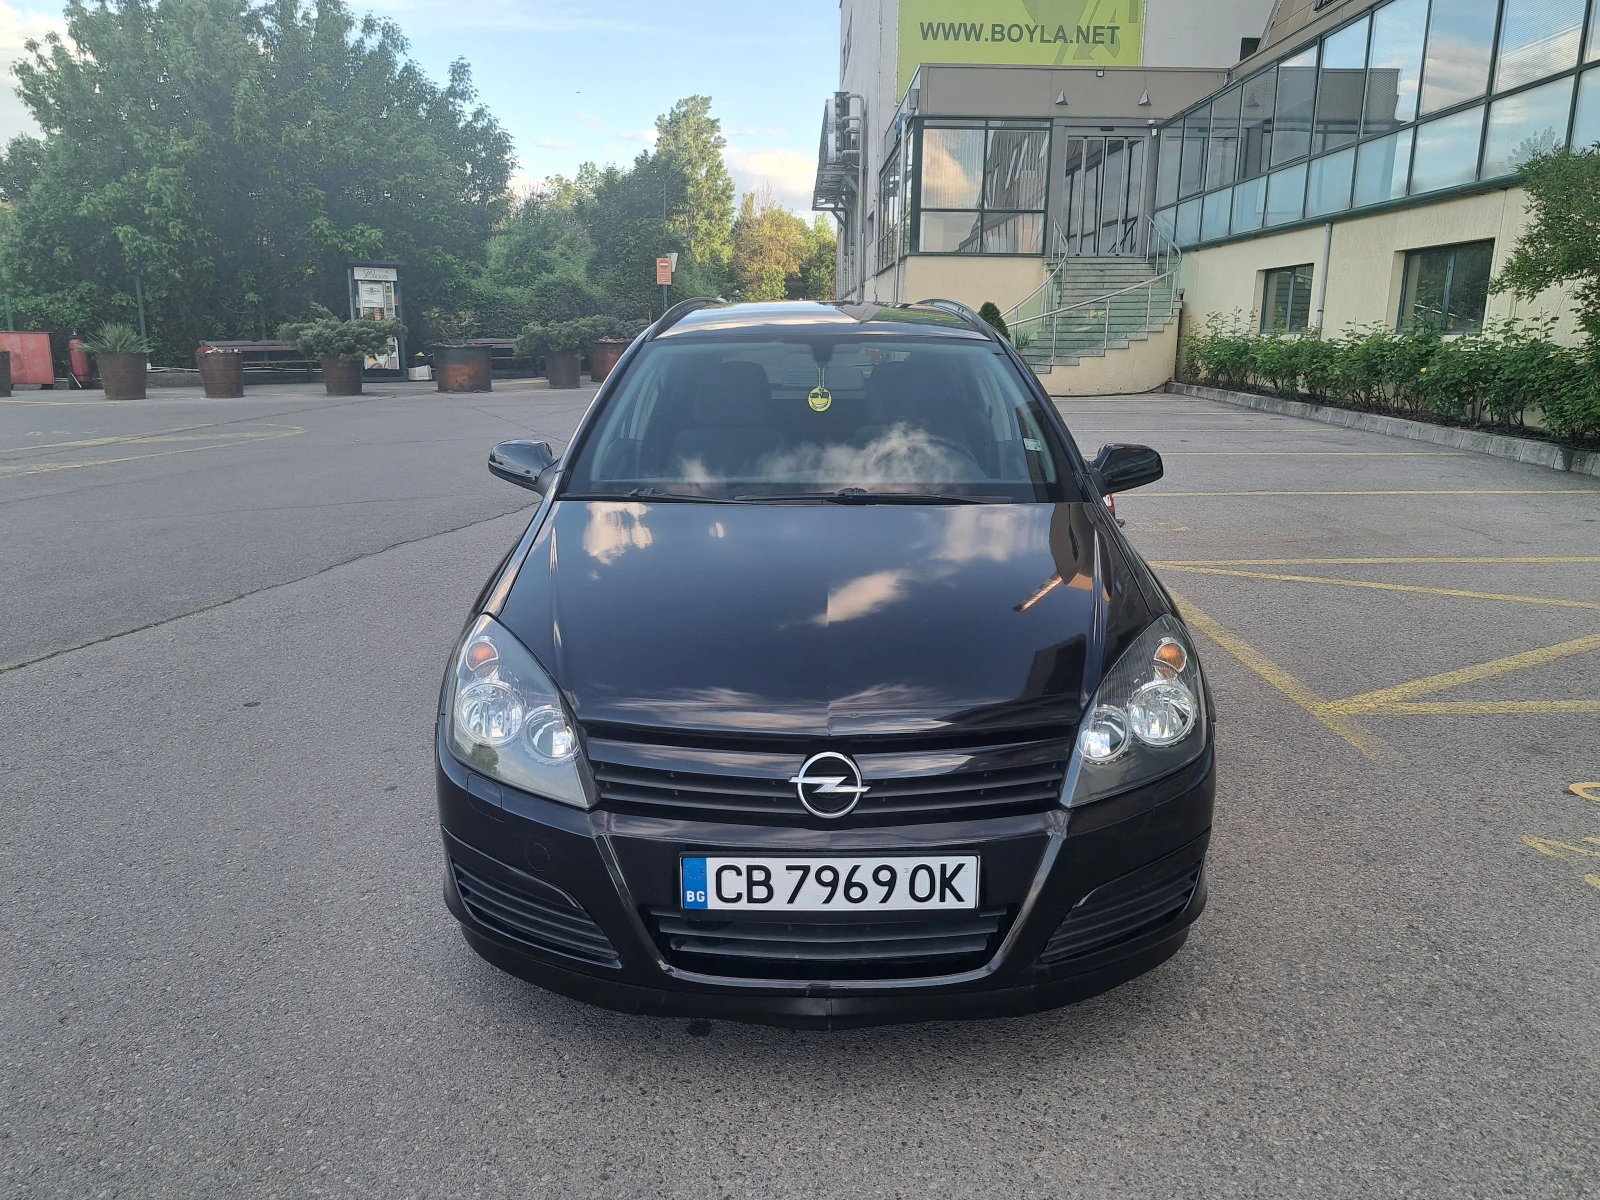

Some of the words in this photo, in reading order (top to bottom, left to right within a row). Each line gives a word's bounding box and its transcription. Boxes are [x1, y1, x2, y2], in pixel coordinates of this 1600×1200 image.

[919, 21, 1121, 45] WWW.BOYLA.NET
[715, 864, 774, 904] CB
[785, 864, 897, 904] 7969
[686, 890, 706, 903] BG
